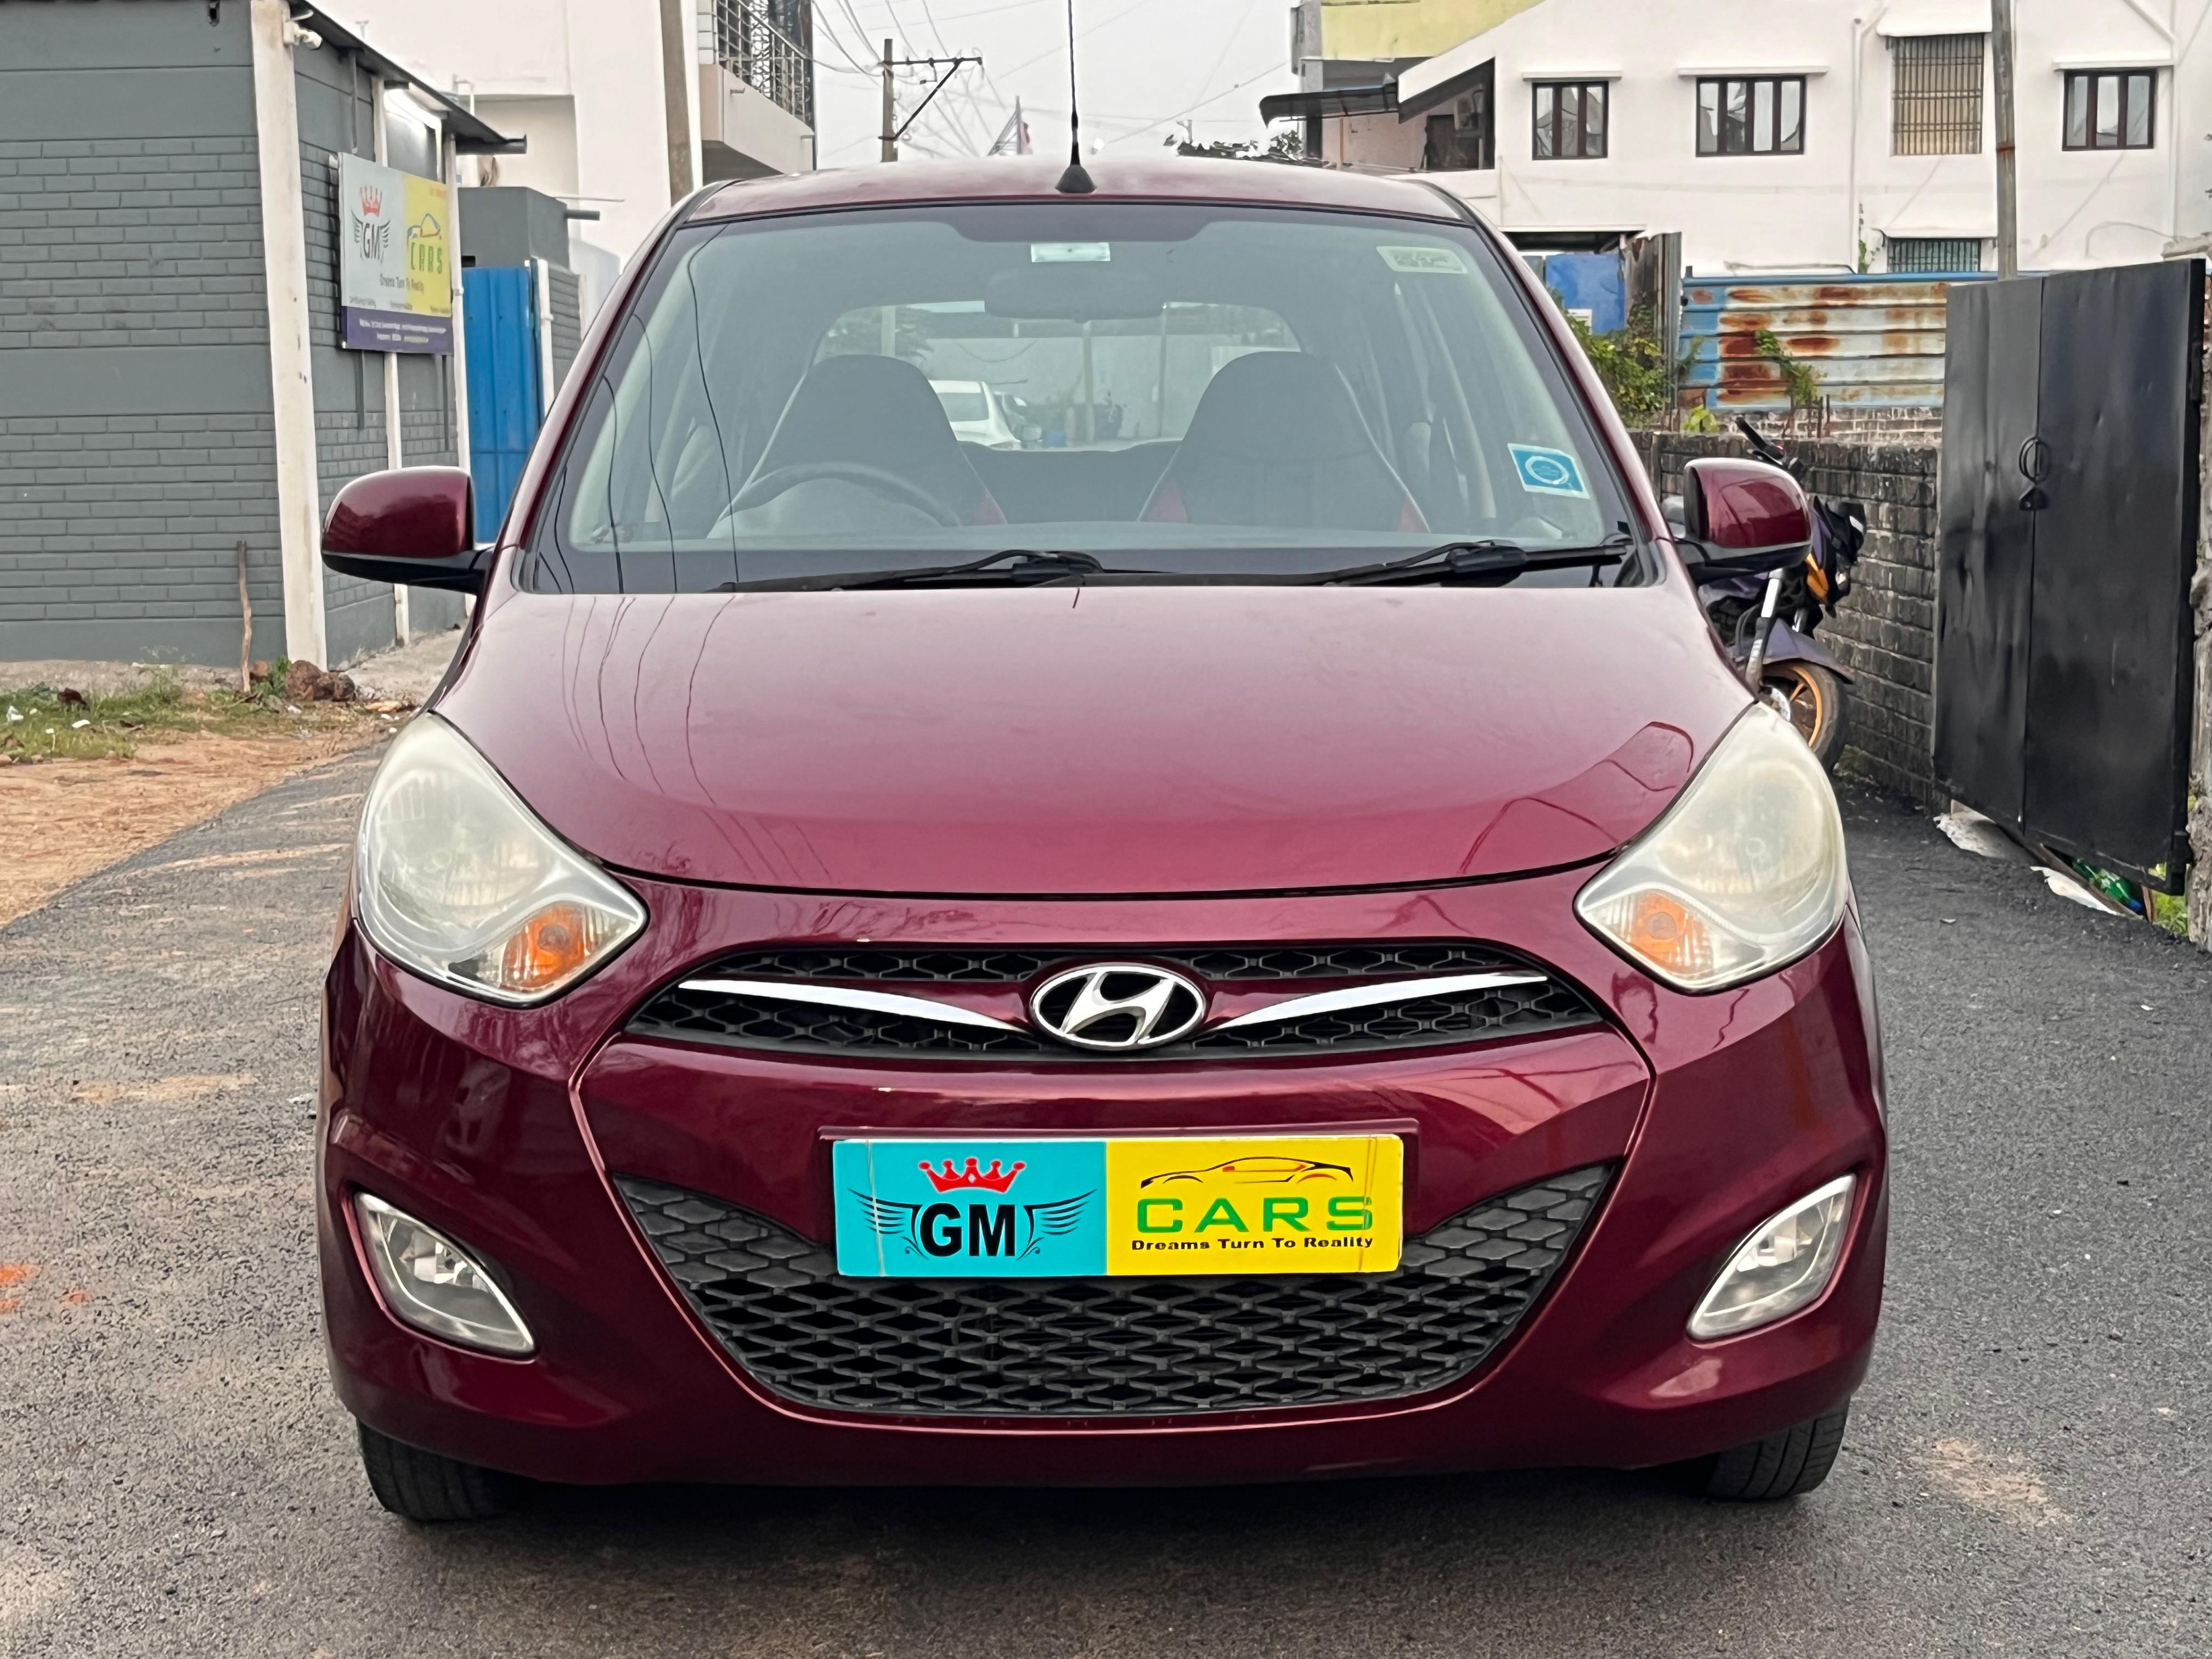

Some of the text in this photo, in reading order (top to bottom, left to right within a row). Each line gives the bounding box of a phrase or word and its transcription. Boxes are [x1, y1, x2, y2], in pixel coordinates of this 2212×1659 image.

[919, 1196, 1373, 1257] GM CARS
[1132, 1237, 1373, 1250] Dreams Turn To Reality
